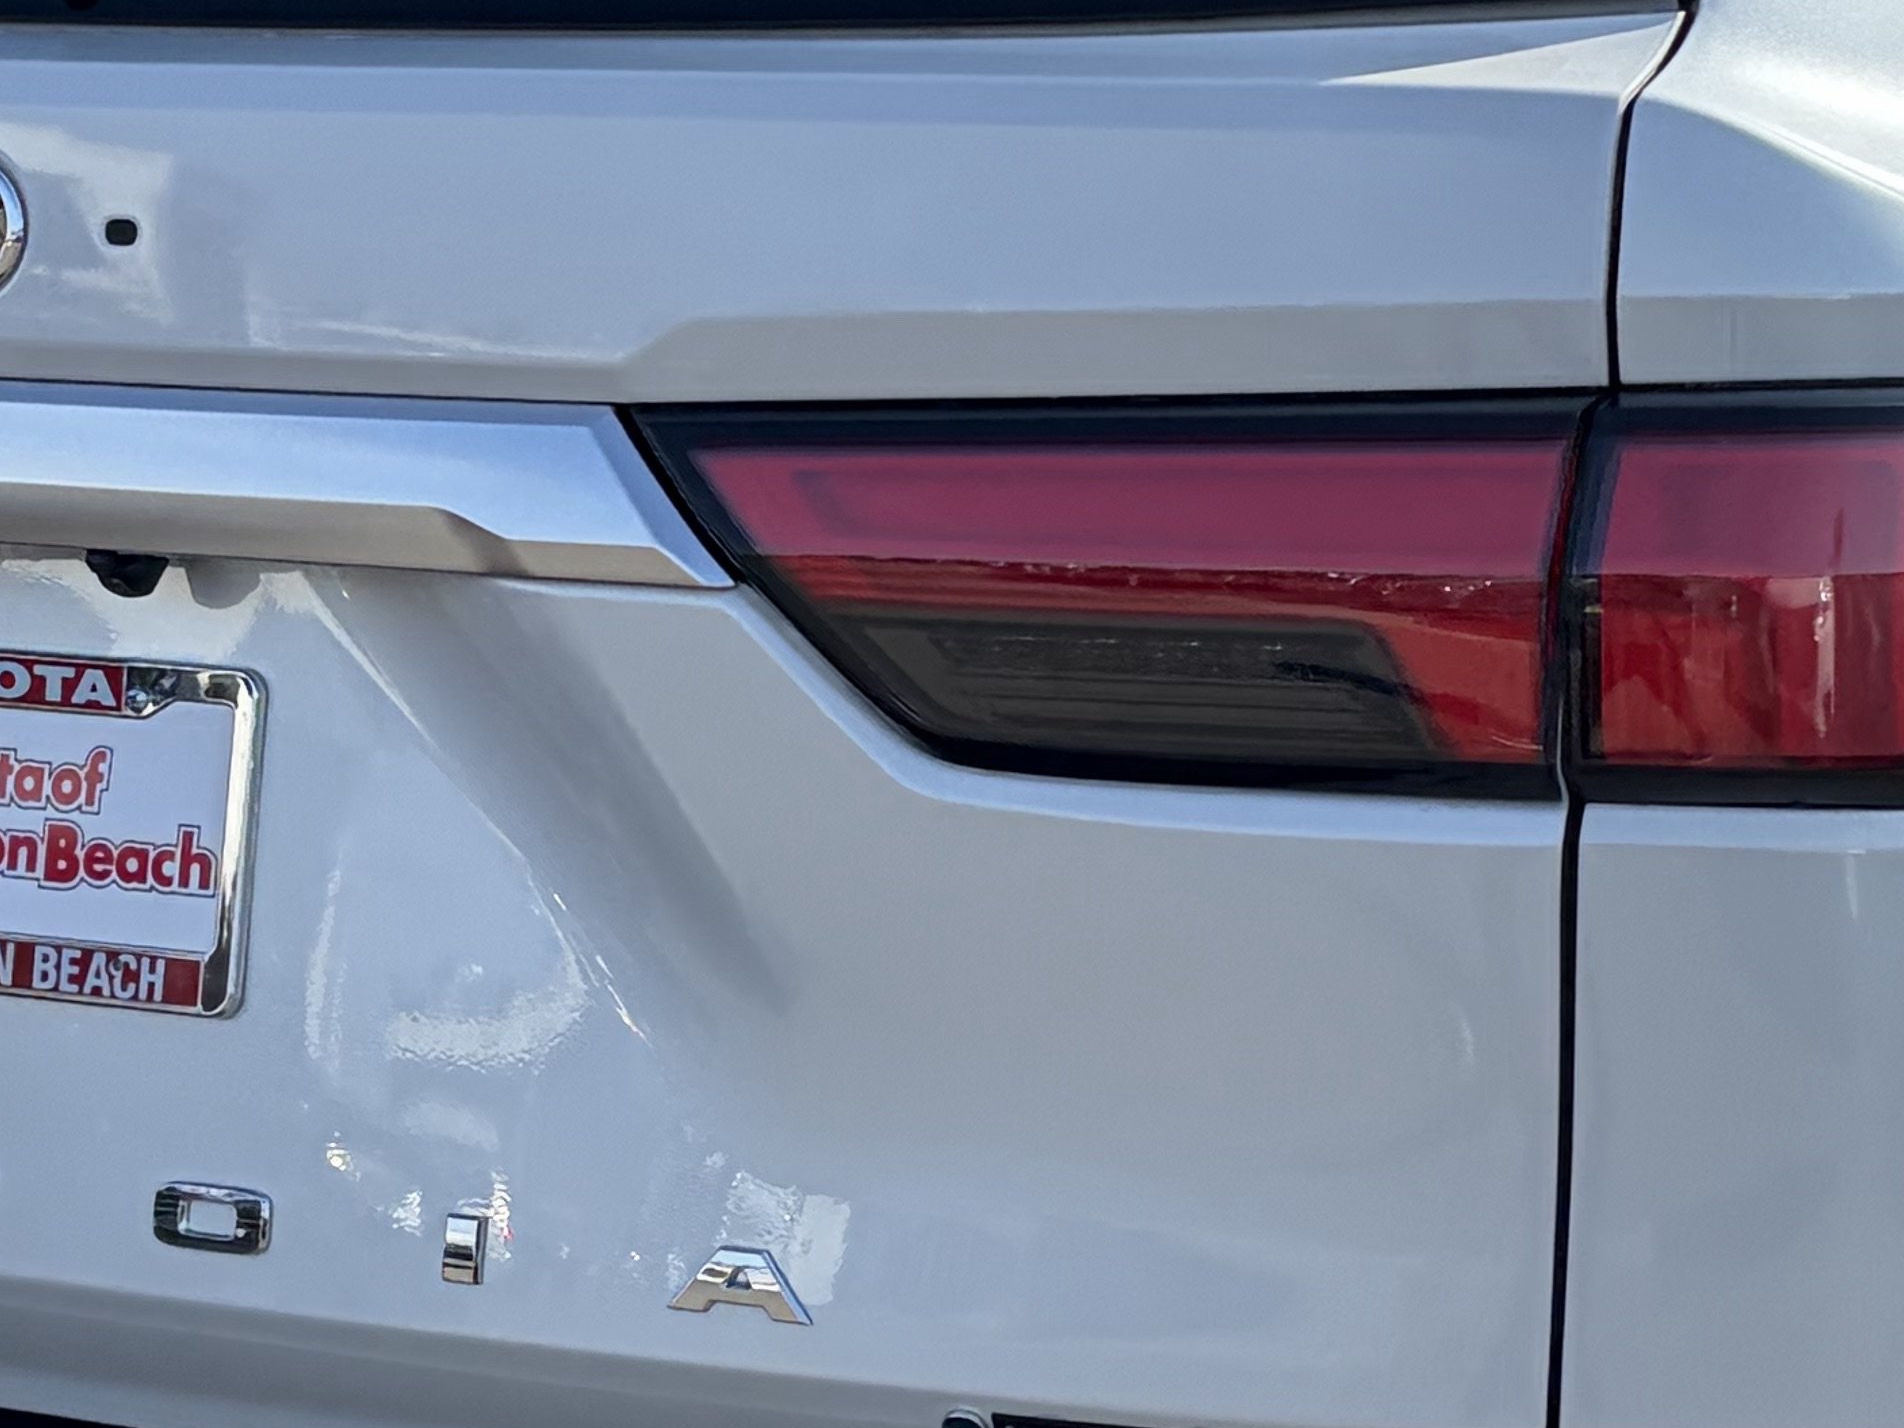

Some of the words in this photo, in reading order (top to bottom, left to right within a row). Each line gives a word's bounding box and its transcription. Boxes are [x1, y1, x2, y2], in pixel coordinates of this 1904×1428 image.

[50, 747, 109, 810] of
[41, 821, 213, 891] Beach
[31, 950, 165, 1002] BEACH
